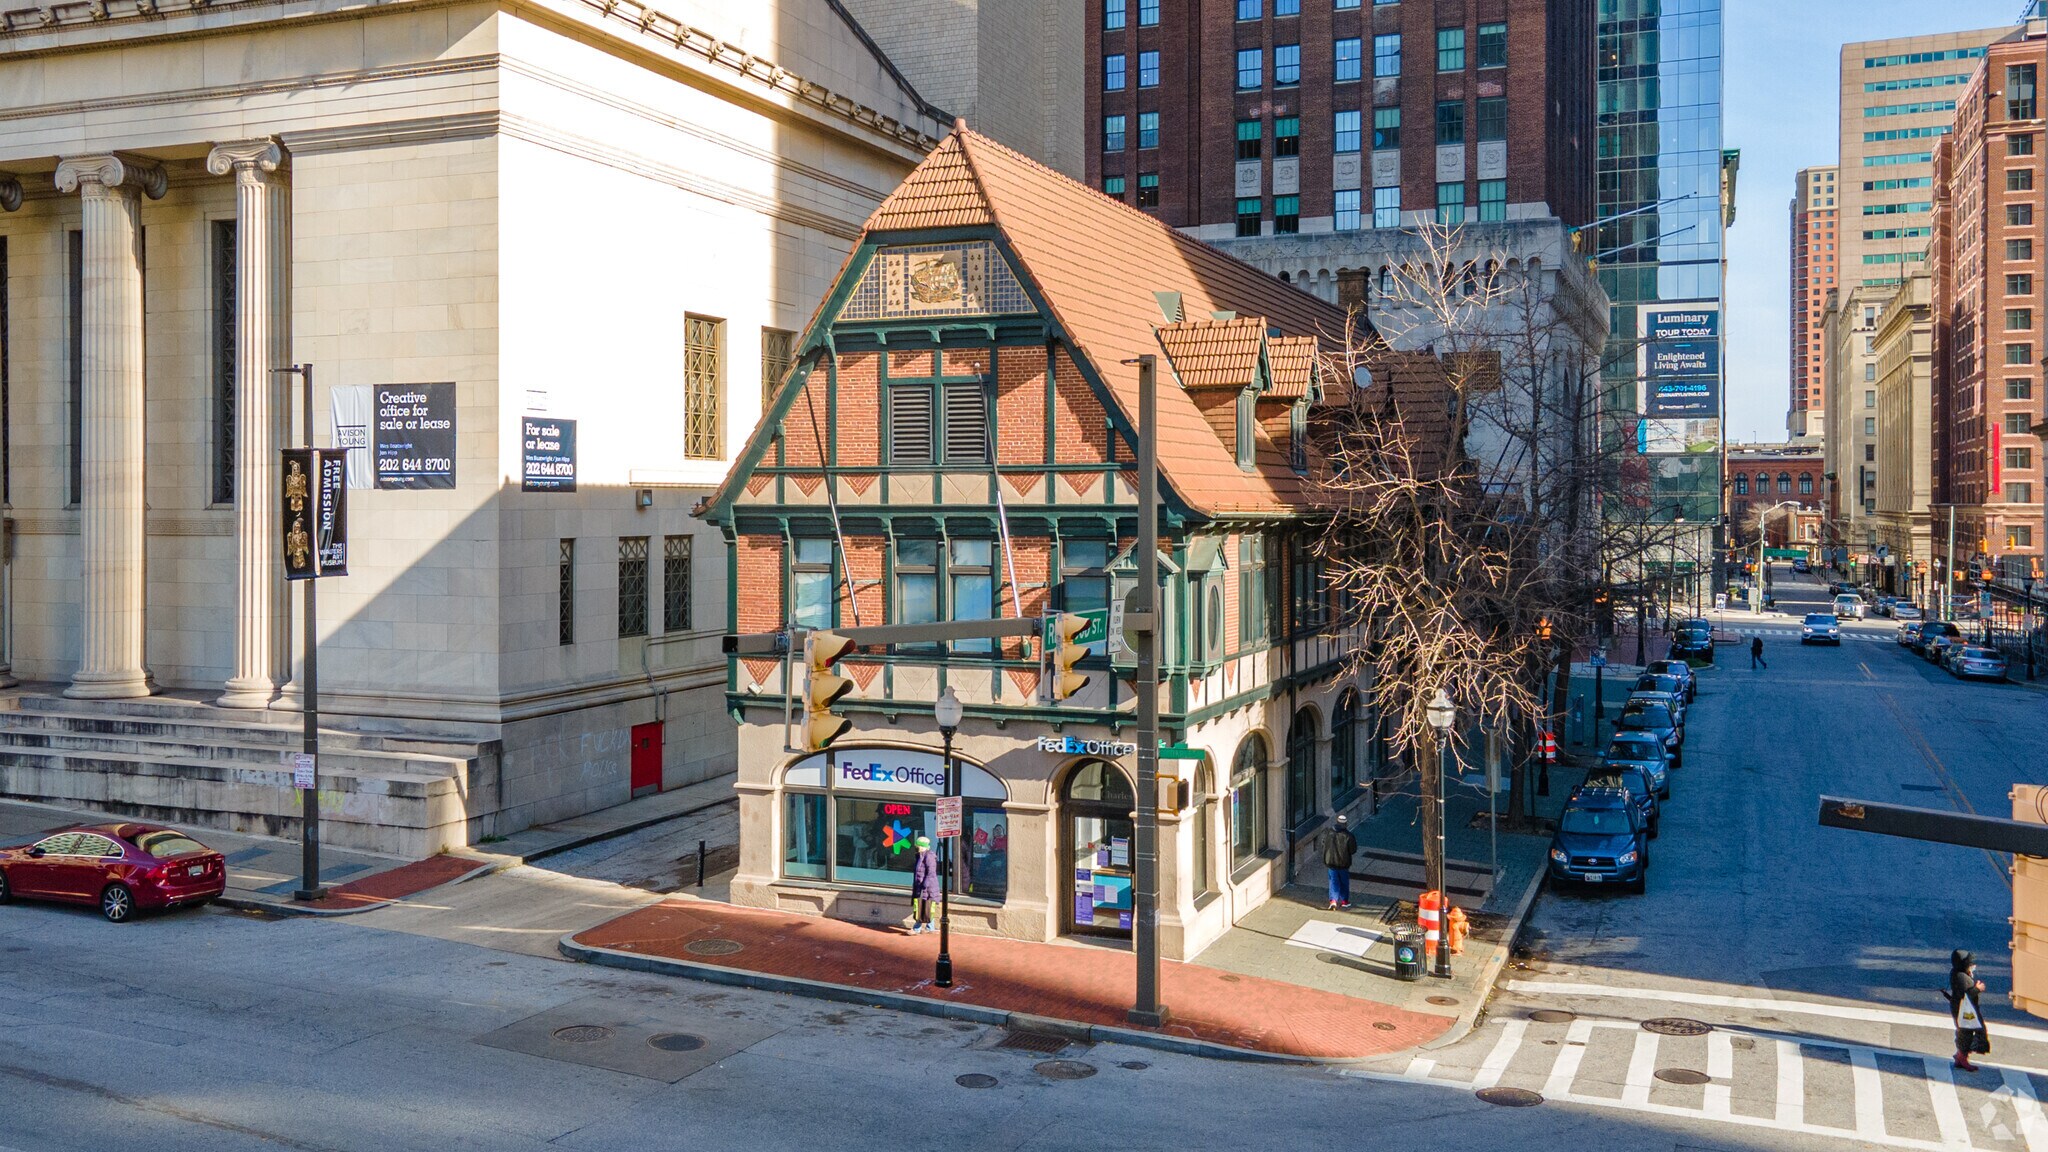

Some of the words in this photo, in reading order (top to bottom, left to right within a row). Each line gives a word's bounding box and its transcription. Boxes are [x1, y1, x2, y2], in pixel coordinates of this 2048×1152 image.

[1657, 313, 1709, 325] Luminary
[1655, 329, 1680, 337] TOUR
[1681, 328, 1711, 336] TODAY
[1657, 352, 1705, 362] Enlightened
[1654, 361, 1679, 371] Living
[1680, 361, 1707, 369] Awaits
[379, 391, 427, 404] Creative
[379, 404, 410, 417] office
[412, 404, 428, 416] for
[380, 417, 403, 430] sale
[405, 420, 417, 429] or
[419, 416, 450, 429] lease
[525, 422, 541, 436] For
[541, 424, 560, 437] sale
[337, 429, 366, 437] AVISON
[338, 438, 366, 446] YOUNG
[525, 440, 536, 449] or
[536, 437, 560, 450] lease
[379, 458, 399, 471] 202
[402, 458, 421, 471] 644
[425, 458, 451, 471] 8700
[525, 462, 541, 475] 202
[541, 462, 555, 475] 644
[555, 463, 573, 476] 8700
[332, 460, 341, 489] FREE
[323, 460, 332, 530] ADMISSION
[1092, 617, 1102, 635] ST.
[1037, 736, 1087, 755] FedEx
[1086, 739, 1132, 756] Office
[842, 761, 894, 783] FedEx
[895, 766, 945, 786] Office
[884, 804, 911, 815] OPEN
